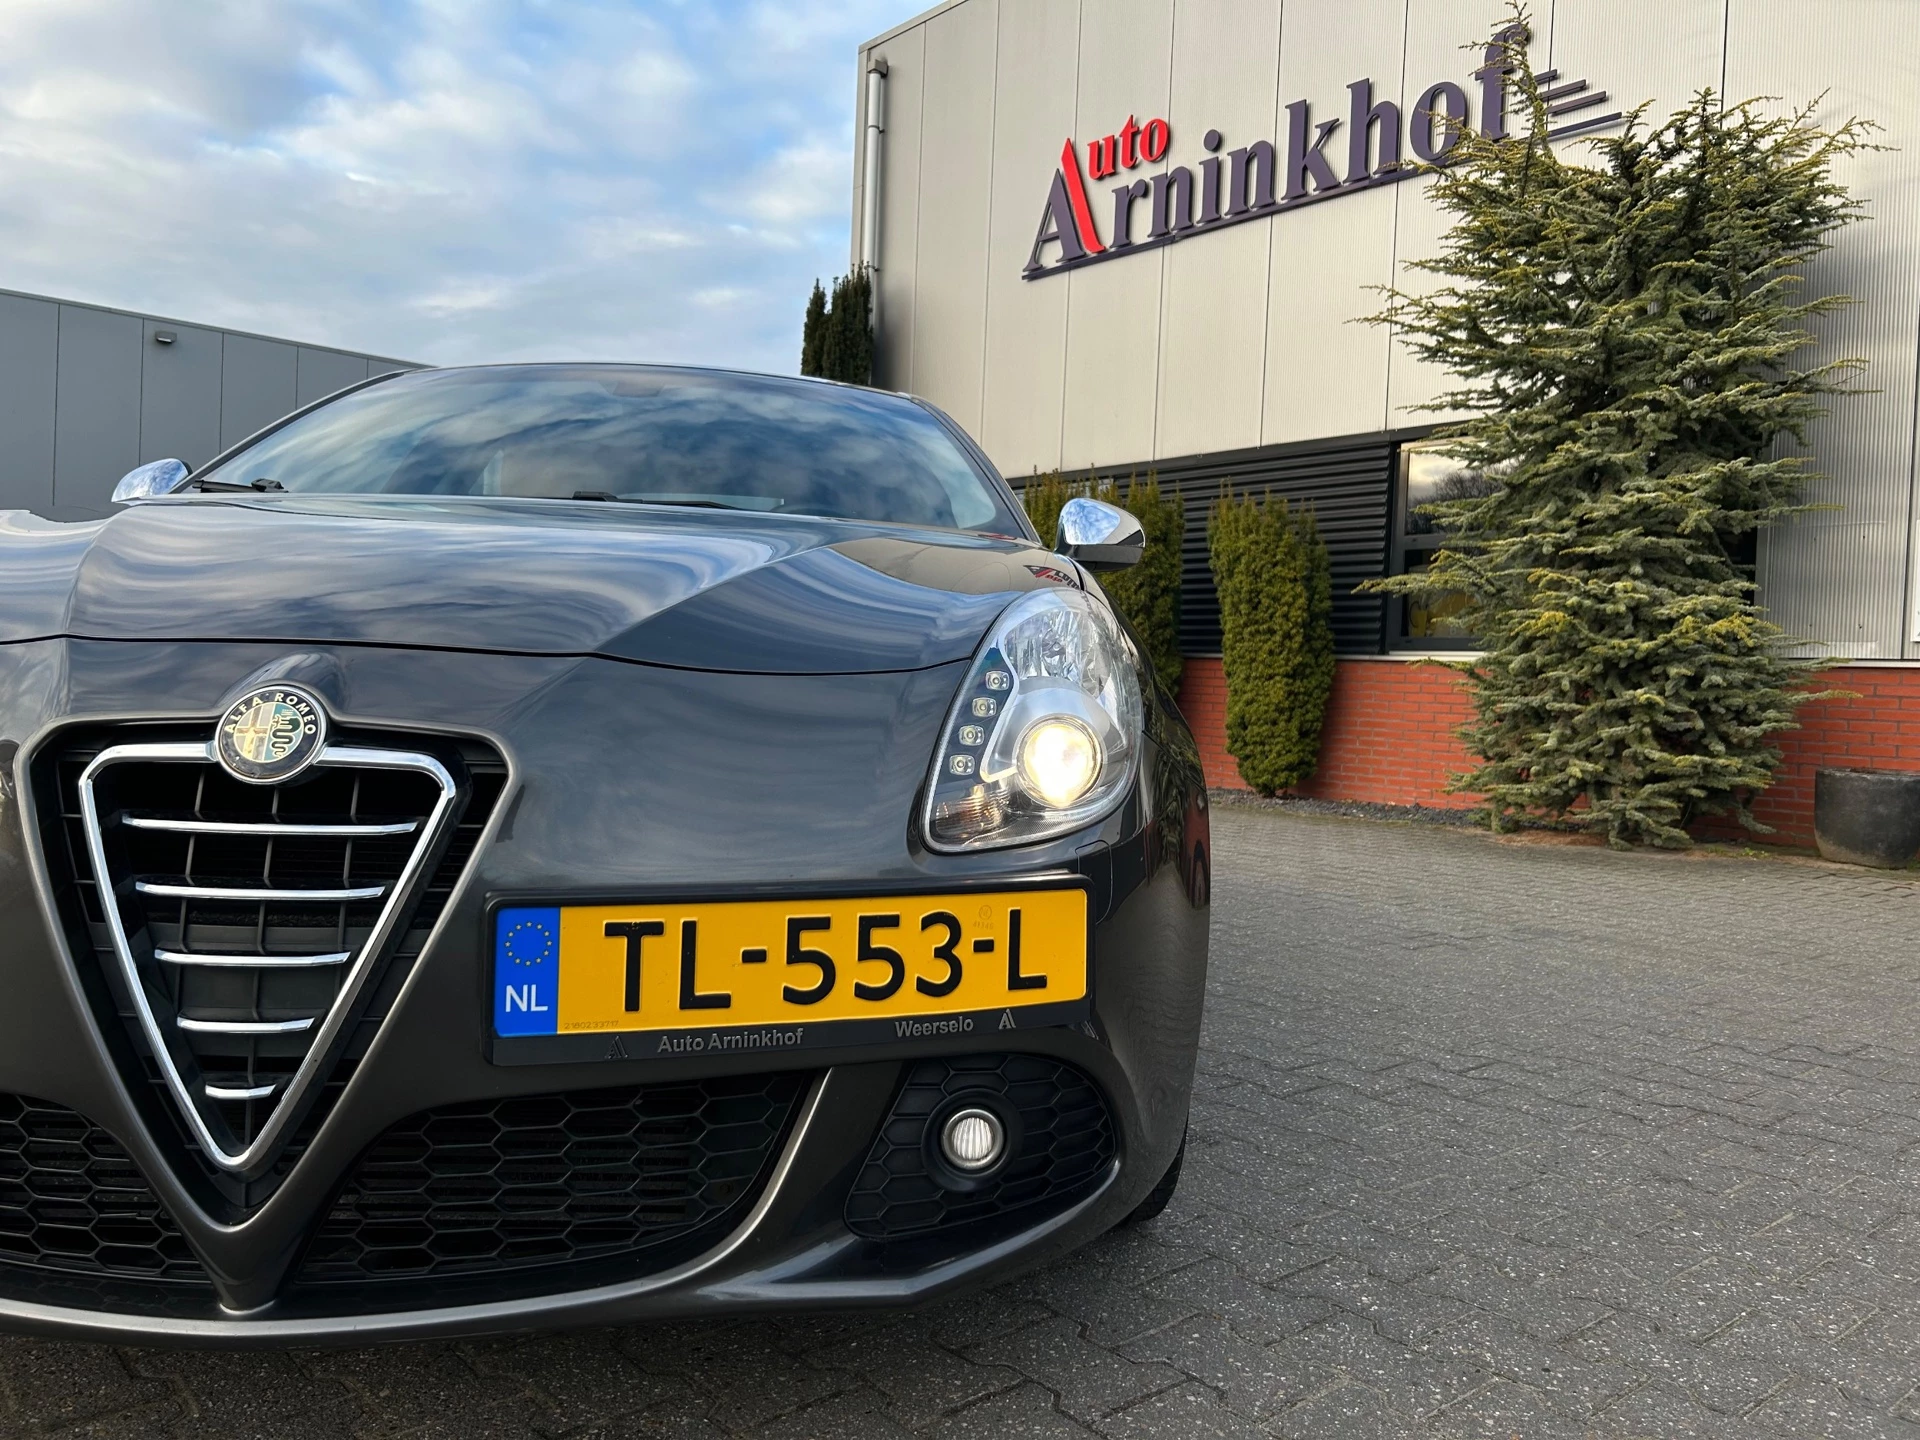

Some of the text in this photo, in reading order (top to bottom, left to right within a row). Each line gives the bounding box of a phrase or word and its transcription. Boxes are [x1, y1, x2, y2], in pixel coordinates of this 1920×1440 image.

[1022, 24, 1530, 272] Arninkhof
[224, 693, 316, 734] ALFA ROMEO
[603, 907, 1048, 1012] TL-553-L
[505, 984, 549, 1013] NL
[657, 1035, 705, 1053] Auto
[707, 1028, 804, 1050] Arninkhof
[894, 1016, 974, 1038] Weerselo
